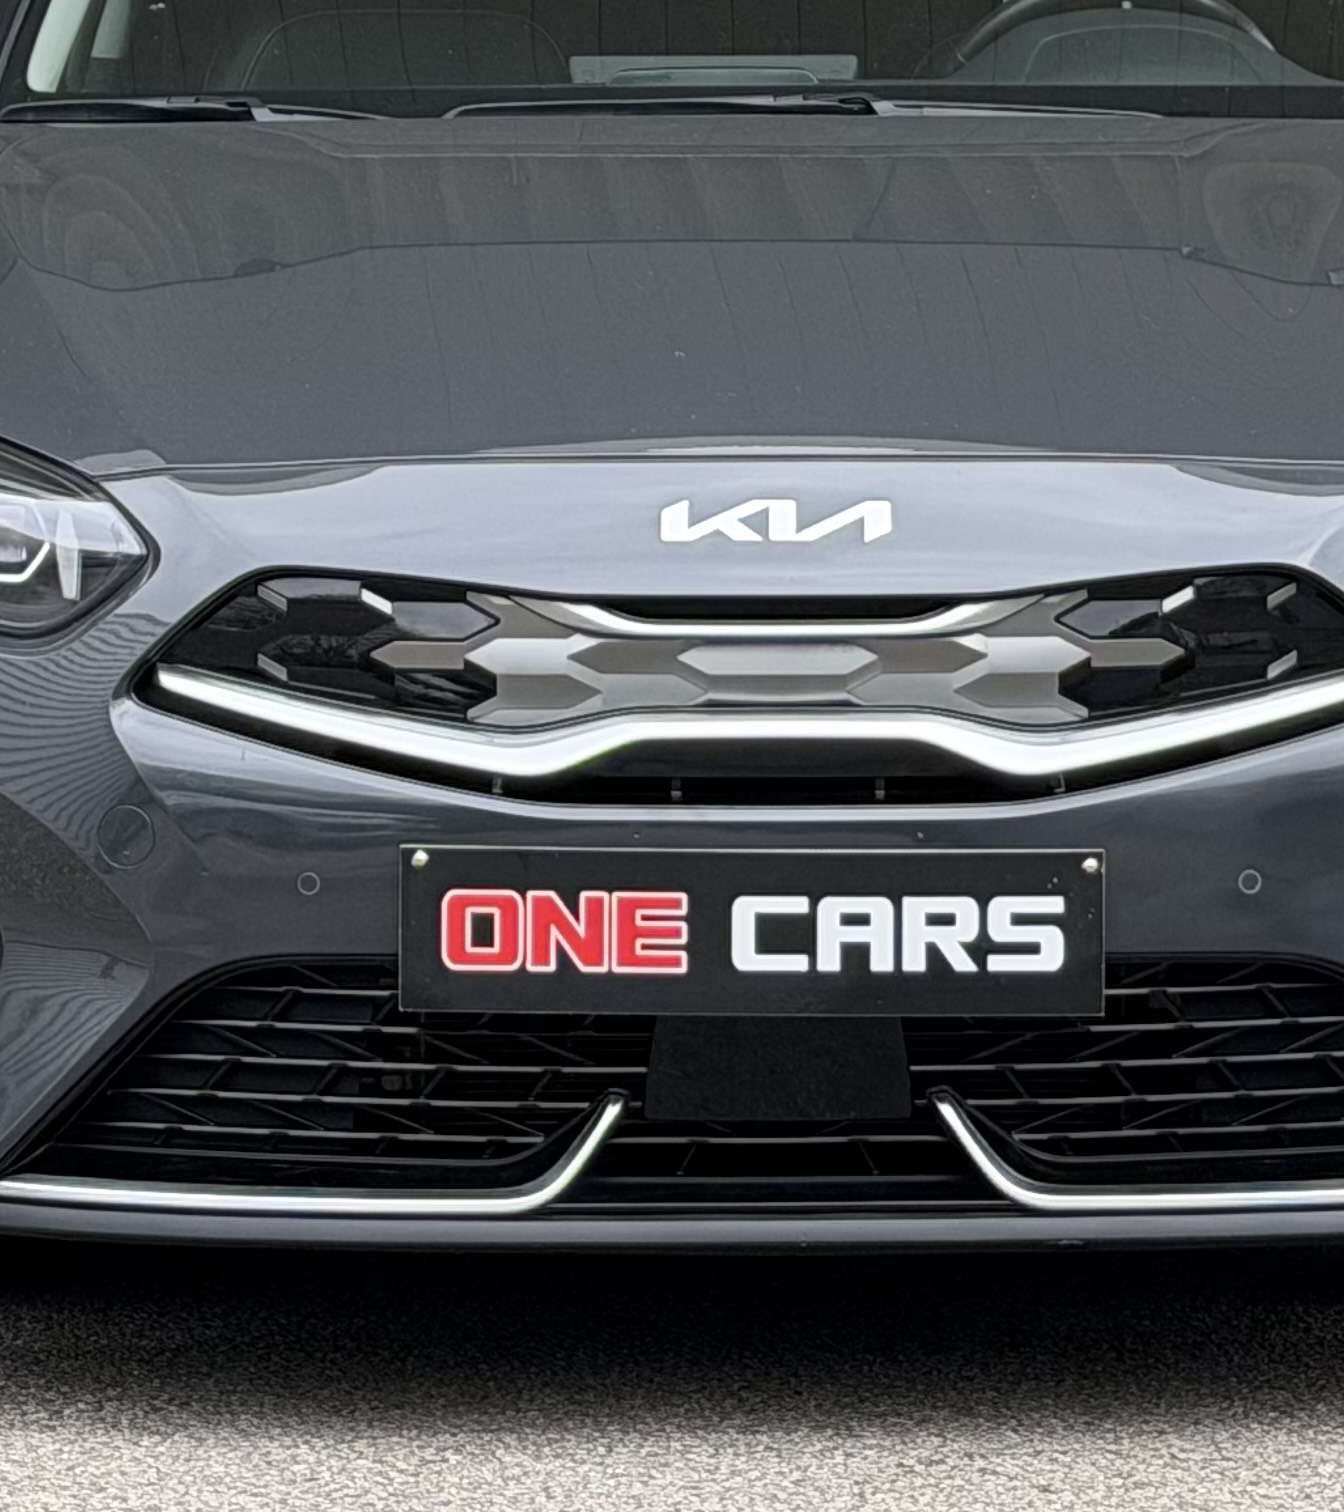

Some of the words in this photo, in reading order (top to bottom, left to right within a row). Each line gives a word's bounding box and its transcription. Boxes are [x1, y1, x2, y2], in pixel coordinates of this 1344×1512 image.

[660, 498, 892, 543] KIA
[441, 888, 688, 974] ONE
[730, 894, 1065, 973] CARS
